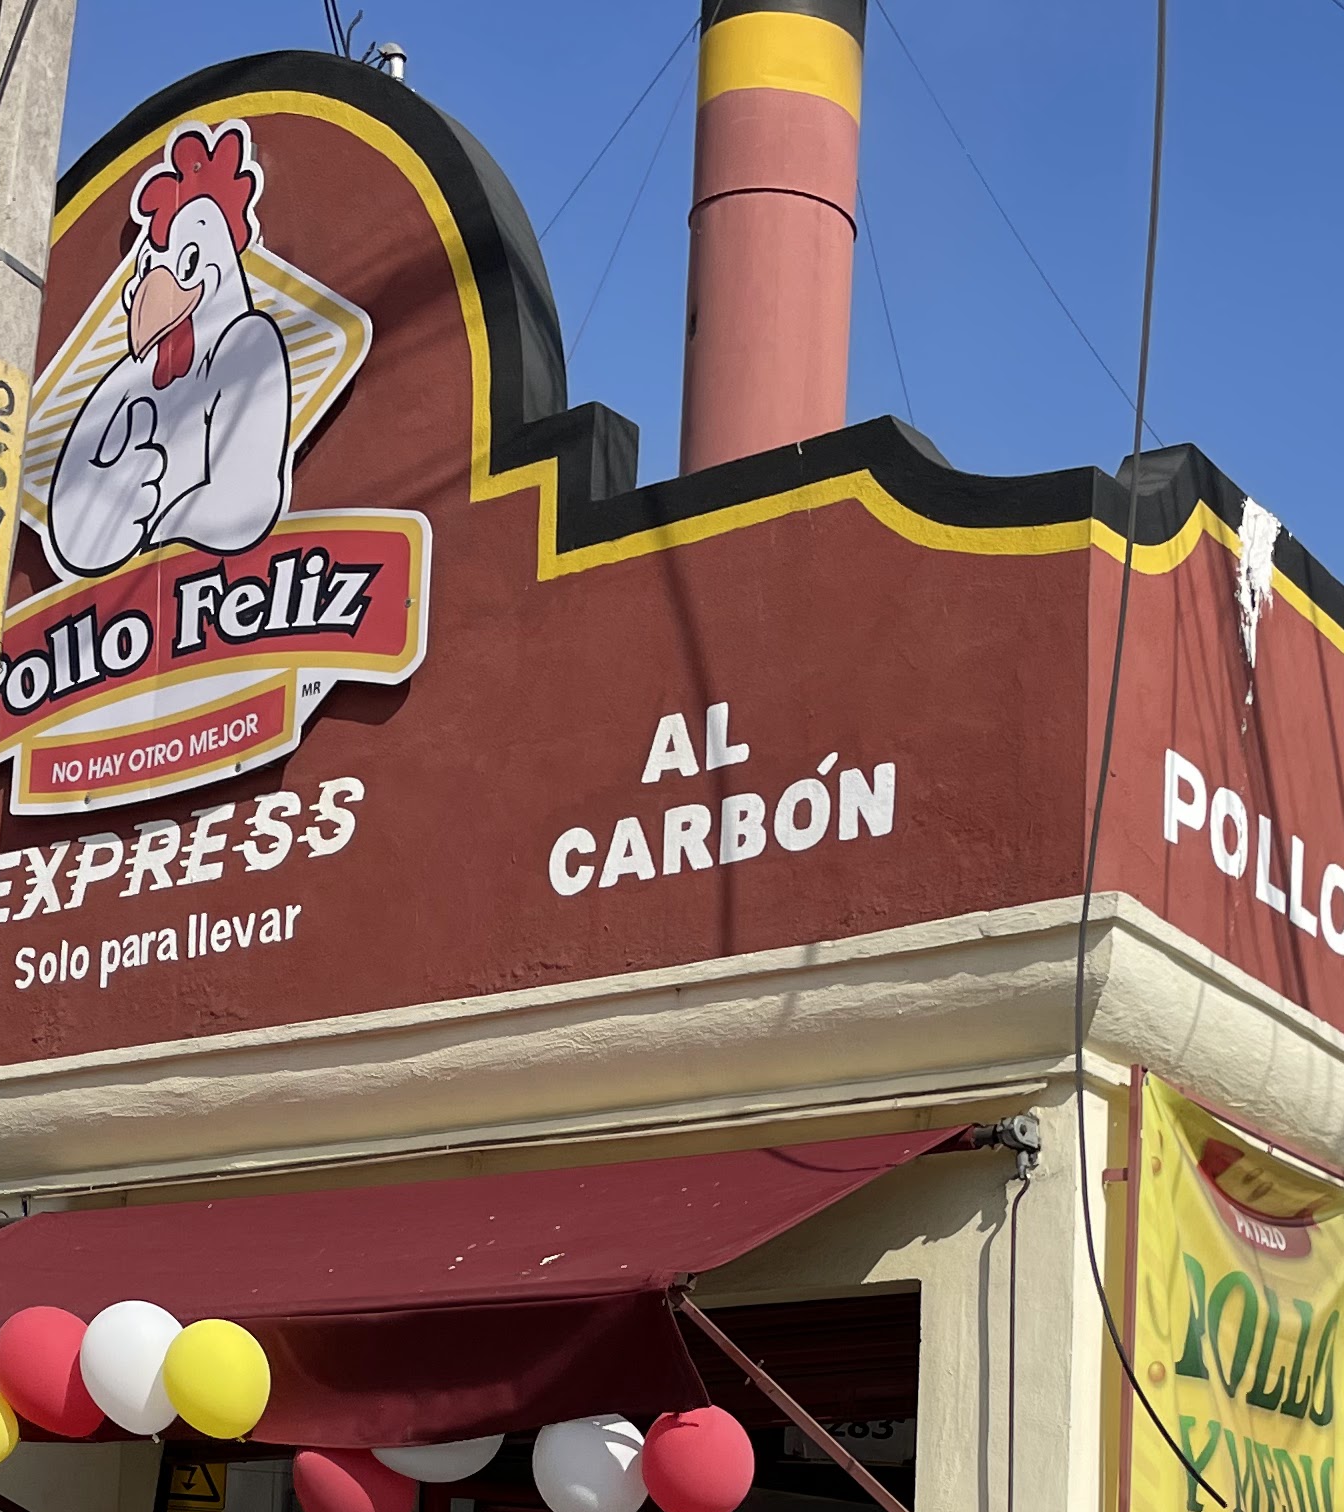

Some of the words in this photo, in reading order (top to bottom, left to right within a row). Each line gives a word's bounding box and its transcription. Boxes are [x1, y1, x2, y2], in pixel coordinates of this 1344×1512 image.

[0, 612, 151, 710] ollo
[175, 553, 372, 652] Feliz
[300, 681, 322, 698] MR
[51, 762, 83, 784] NO
[88, 752, 125, 781] HAY
[128, 738, 183, 772] OTRO
[189, 712, 259, 757] MEJOR
[641, 701, 750, 784] AL
[548, 752, 896, 896] CARBÓN
[14, 938, 90, 990] Solo
[99, 926, 178, 989] para
[187, 903, 302, 960] llevar
[1175, 1251, 1340, 1427] POLLO
